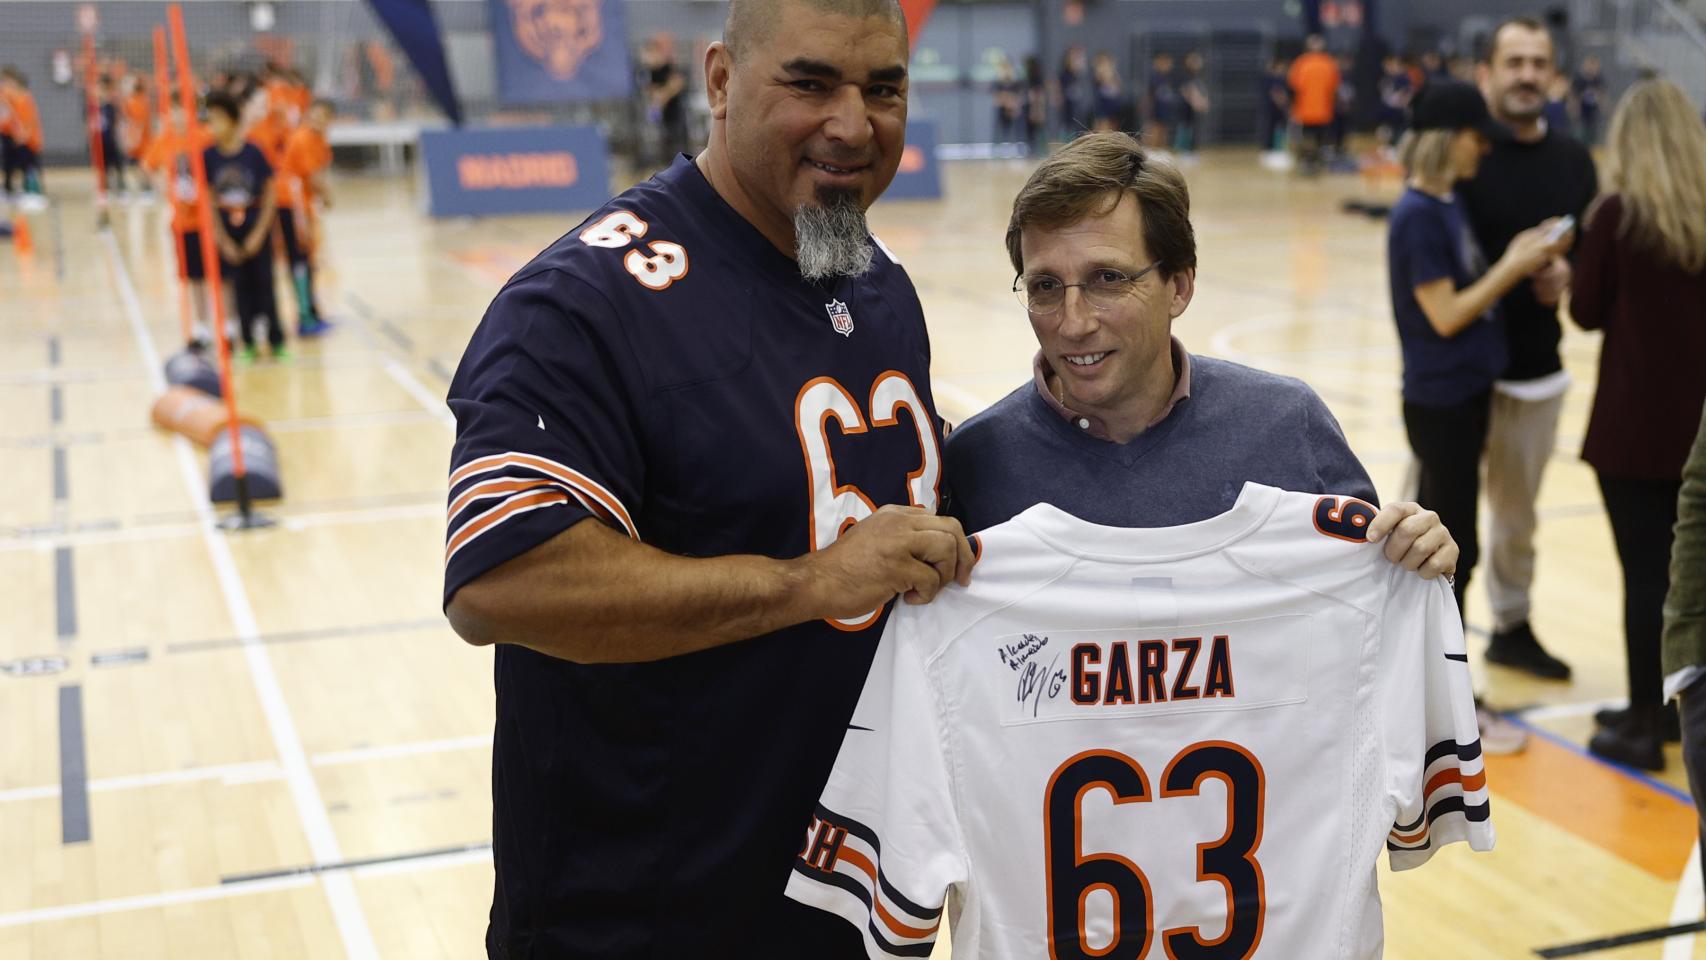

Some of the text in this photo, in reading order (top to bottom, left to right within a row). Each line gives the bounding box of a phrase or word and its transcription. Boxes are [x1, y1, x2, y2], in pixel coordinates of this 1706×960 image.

[579, 210, 689, 290] 63
[1070, 635, 1235, 705] GARZA
[1043, 740, 1266, 960] 63
